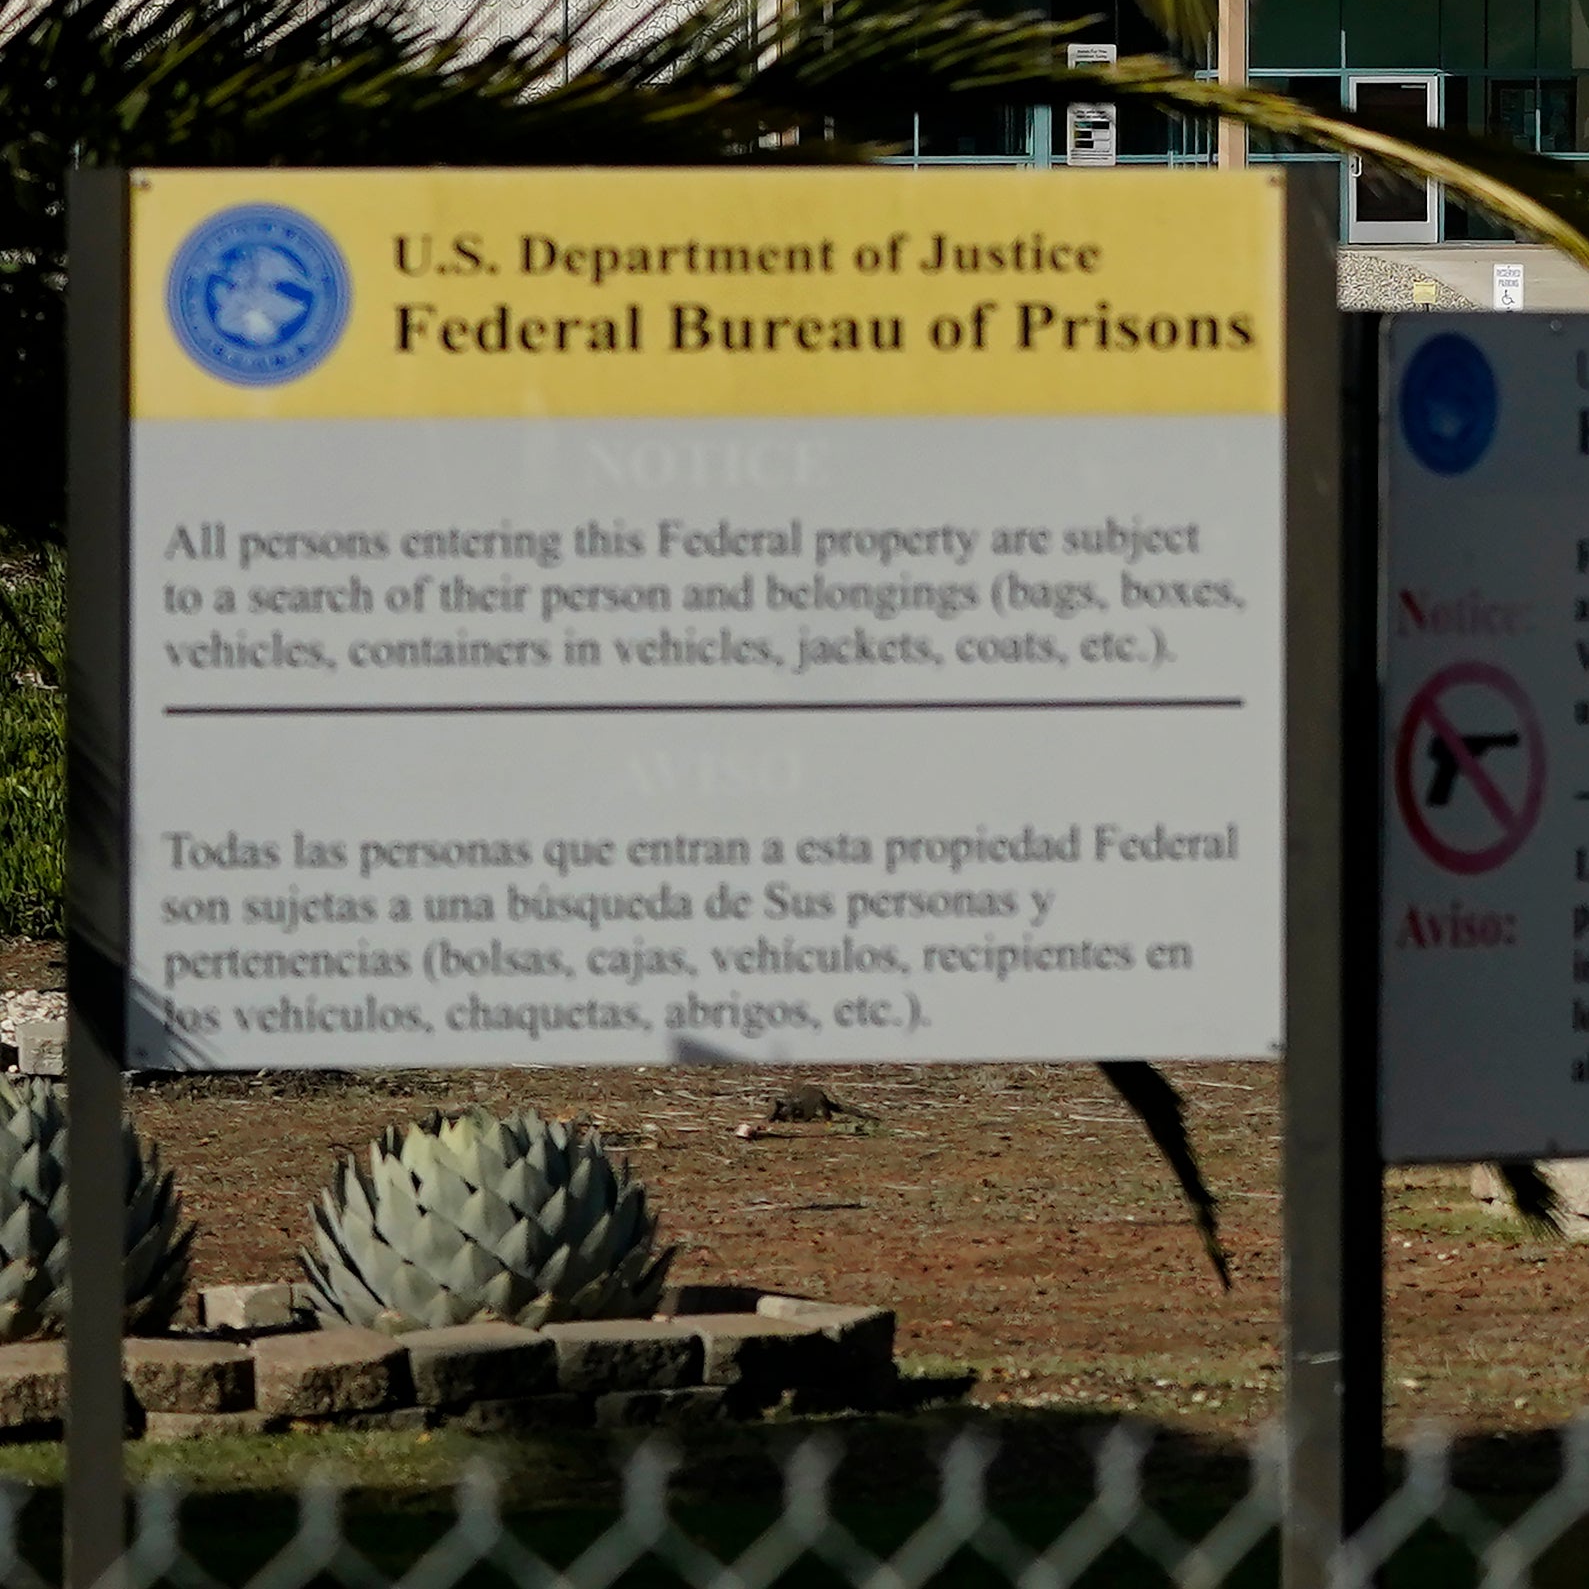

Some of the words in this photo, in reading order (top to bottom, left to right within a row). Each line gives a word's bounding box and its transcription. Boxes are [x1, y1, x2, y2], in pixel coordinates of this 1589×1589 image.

[394, 235, 498, 275] U.S.
[520, 234, 834, 286] Department
[853, 234, 907, 274] of
[920, 233, 1100, 273] Justice
[396, 303, 641, 354] Federal
[670, 302, 903, 353] Bureau
[929, 301, 996, 352] of
[1017, 300, 1255, 351] Prisons
[164, 522, 226, 560] All
[239, 532, 390, 571] persons
[400, 520, 563, 570] entering
[574, 519, 646, 558] this
[657, 518, 802, 557] Federal
[814, 524, 979, 567] property
[991, 528, 1052, 555] are
[1063, 516, 1200, 566] subject
[163, 585, 203, 615] to
[213, 589, 237, 615] a
[248, 577, 374, 615] search
[384, 576, 434, 614] of
[439, 576, 531, 613] their
[541, 586, 672, 624] person
[682, 575, 755, 612] and
[766, 573, 981, 623] belongings
[990, 573, 1109, 621] (bags,
[1120, 572, 1246, 616] boxes,
[164, 631, 338, 675] vehicles,
[348, 630, 552, 668] containers
[563, 630, 601, 667] in
[613, 628, 785, 672] vehicles,
[797, 628, 945, 676] jackets,
[955, 634, 1069, 670] coats,
[1079, 633, 1175, 675] etc.).
[162, 830, 281, 869] Todas
[293, 830, 348, 868] las
[359, 839, 533, 877] personas
[543, 839, 616, 875] que
[626, 834, 751, 866] entran
[761, 837, 785, 865] a
[796, 833, 873, 864] esta
[885, 824, 1081, 873] propiedad
[1094, 823, 1239, 862] Federal
[161, 896, 230, 924] son
[242, 884, 378, 933] sujetas
[388, 895, 412, 922] a
[423, 894, 496, 922] una
[507, 882, 694, 931] búsqueda
[704, 881, 753, 919] de
[764, 880, 836, 919] Sus
[846, 890, 1019, 928] personas
[1030, 890, 1054, 927] y
[1396, 898, 1520, 950] Aviso:
[163, 938, 412, 990] pertenencias
[422, 937, 576, 987] (bolsas,
[586, 936, 698, 986] cajas,
[922, 931, 1132, 982] recipientes
[1145, 941, 1193, 970] en
[445, 991, 653, 1043] chaquetas,
[665, 990, 822, 1041] abrigos,
[833, 996, 930, 1040] etc.).
